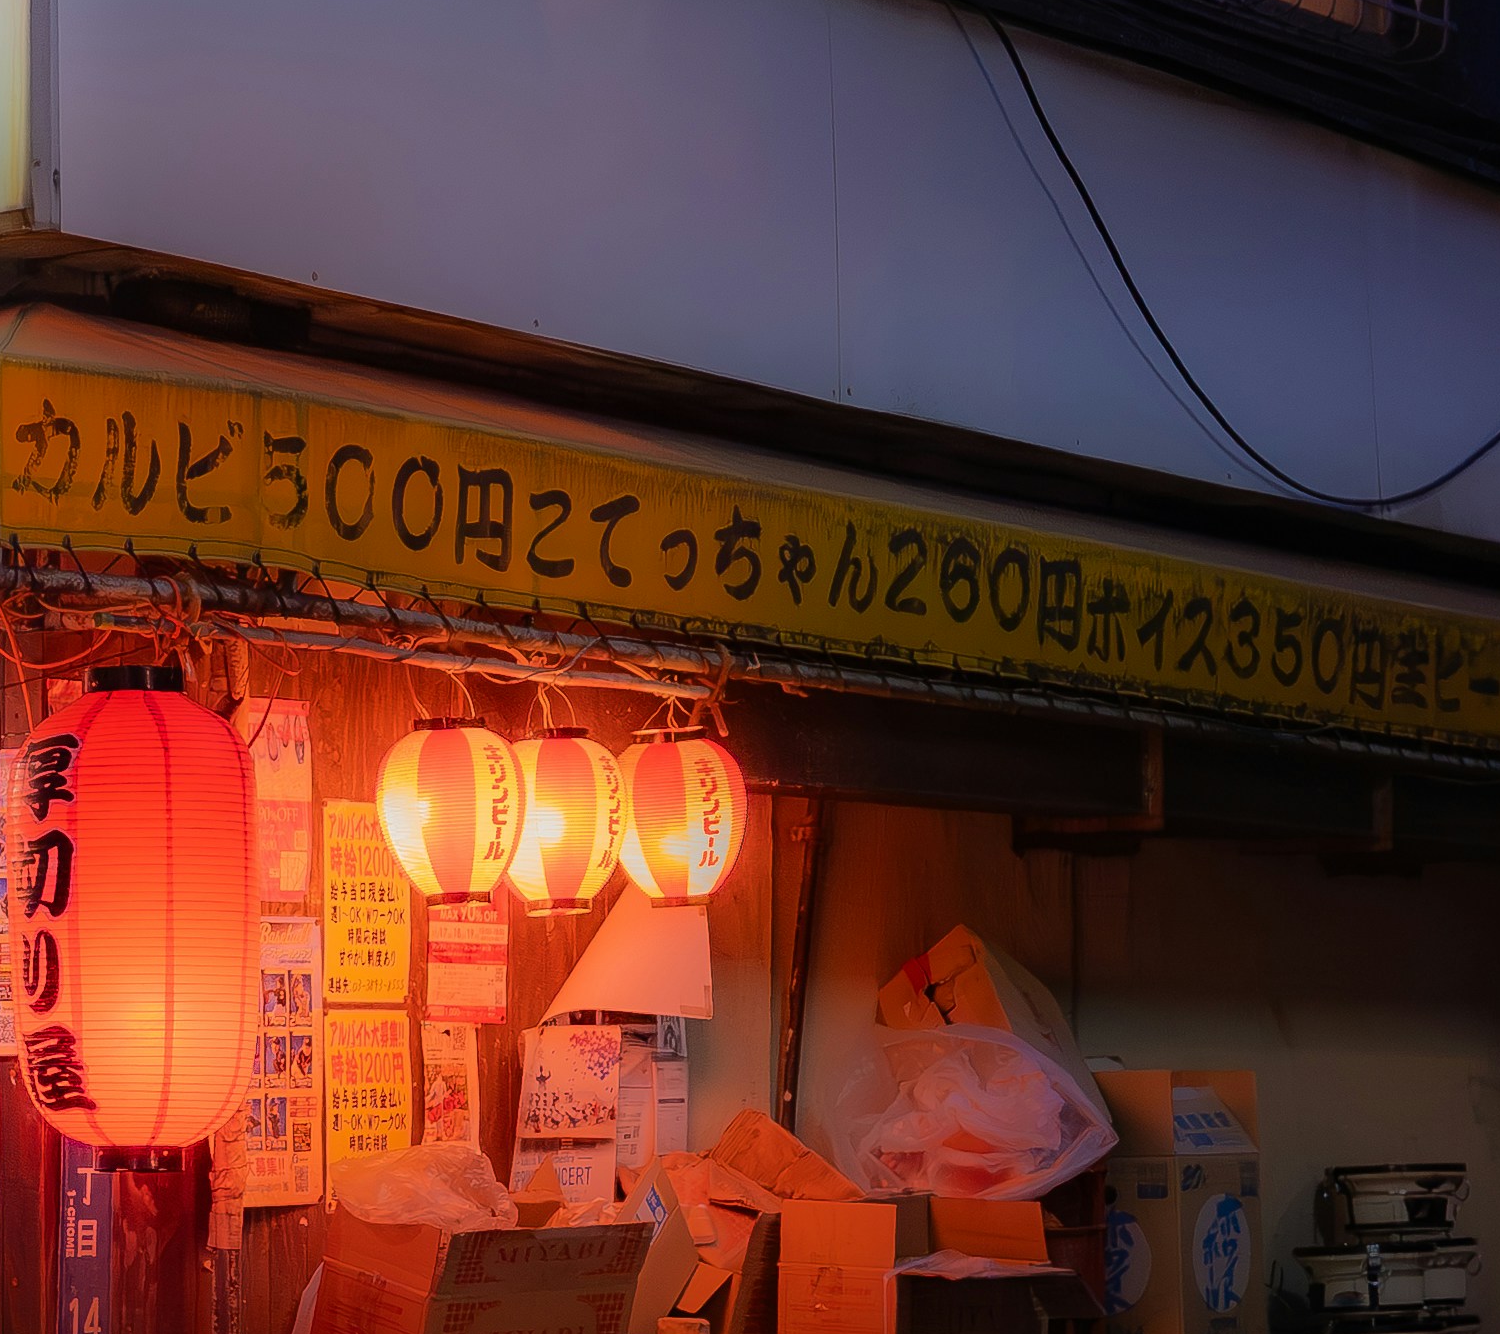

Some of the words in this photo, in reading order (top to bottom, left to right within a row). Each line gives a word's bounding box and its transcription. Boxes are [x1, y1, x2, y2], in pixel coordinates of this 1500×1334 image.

[482, 743, 515, 863] キリンビール
[694, 757, 723, 869] キリンビール
[347, 927, 387, 946] 時間応相談
[329, 1019, 405, 1049] アルバイト大募集!!
[331, 1049, 405, 1087] 時給1200円
[349, 1134, 388, 1152] 時間応相談
[495, 1239, 606, 1264] MIYABI
